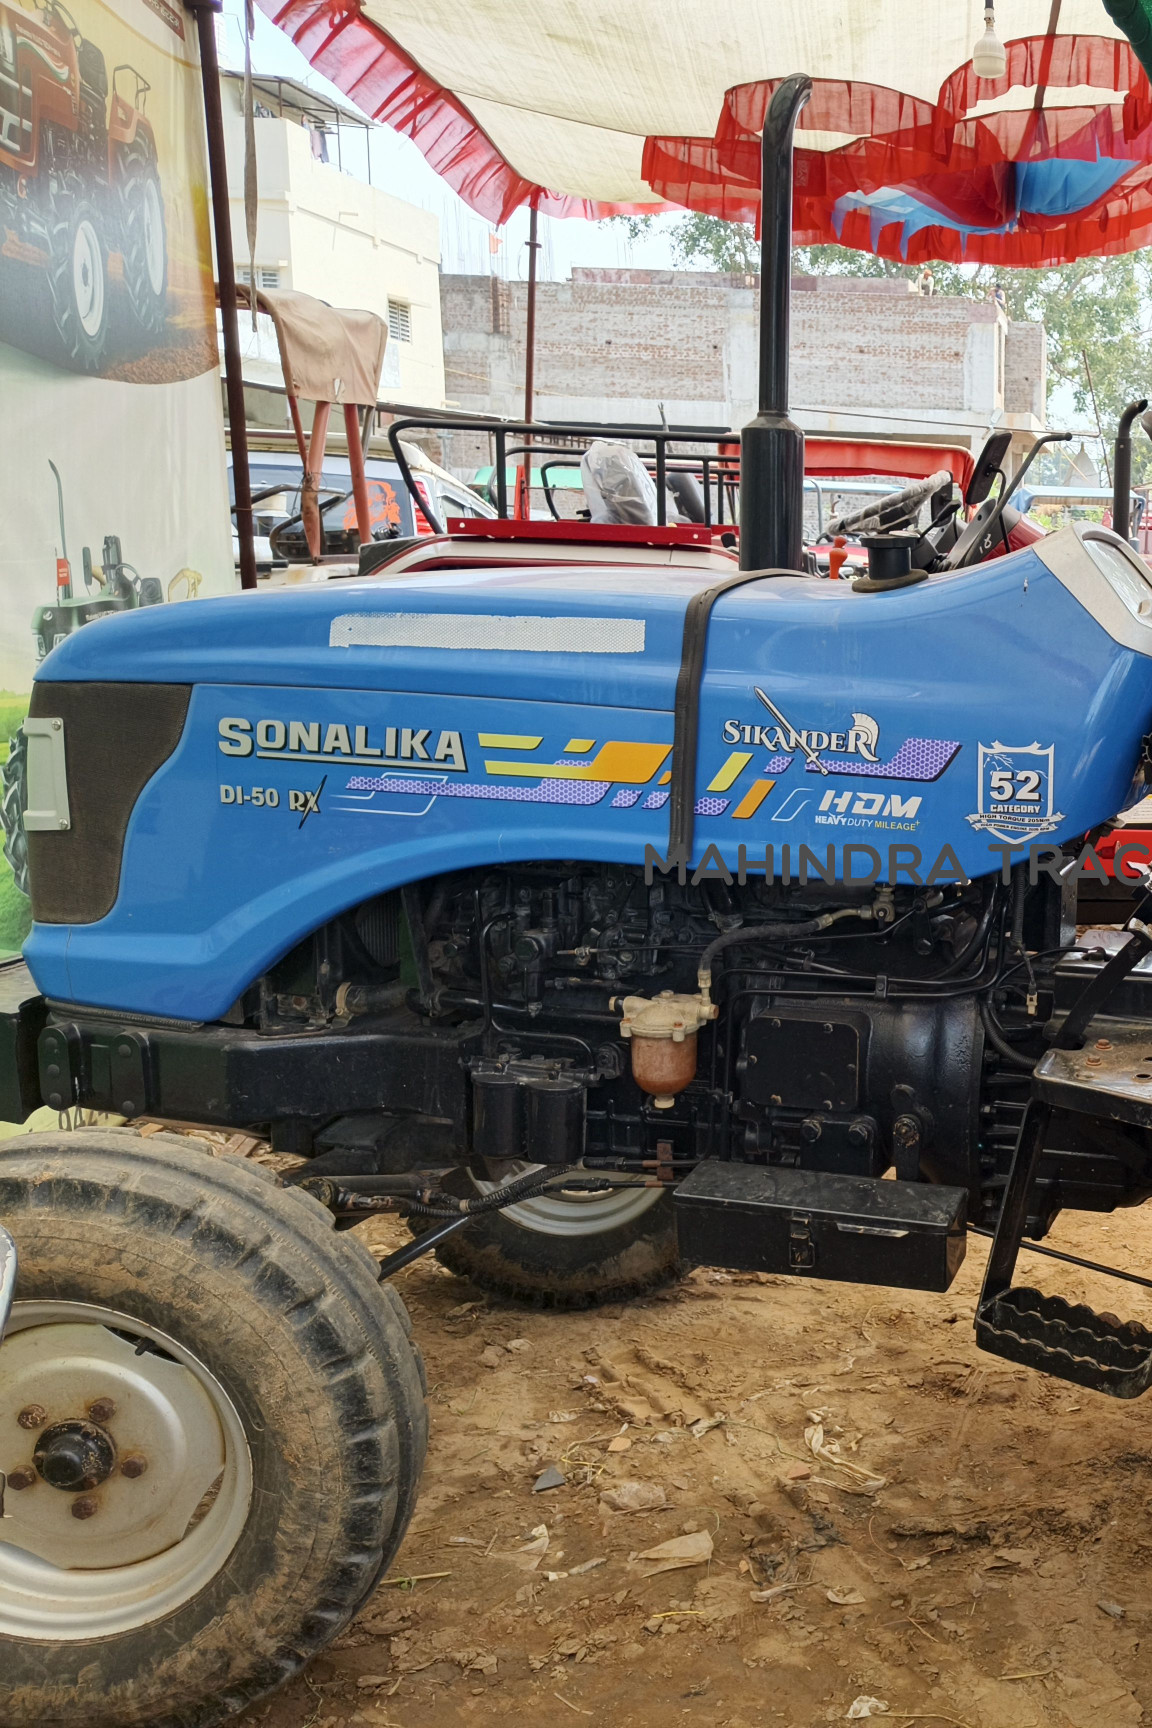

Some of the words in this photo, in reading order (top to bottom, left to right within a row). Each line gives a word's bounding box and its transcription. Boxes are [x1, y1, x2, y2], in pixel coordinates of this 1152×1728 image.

[218, 717, 468, 772] SONALIKA
[722, 717, 881, 762] SIKANDER
[219, 784, 279, 808] DI-50
[289, 780, 324, 820] RX
[989, 770, 1041, 802] 52
[819, 790, 922, 818] HDM
[990, 804, 1041, 814] CATEGORY
[998, 814, 1026, 823] TORQUE
